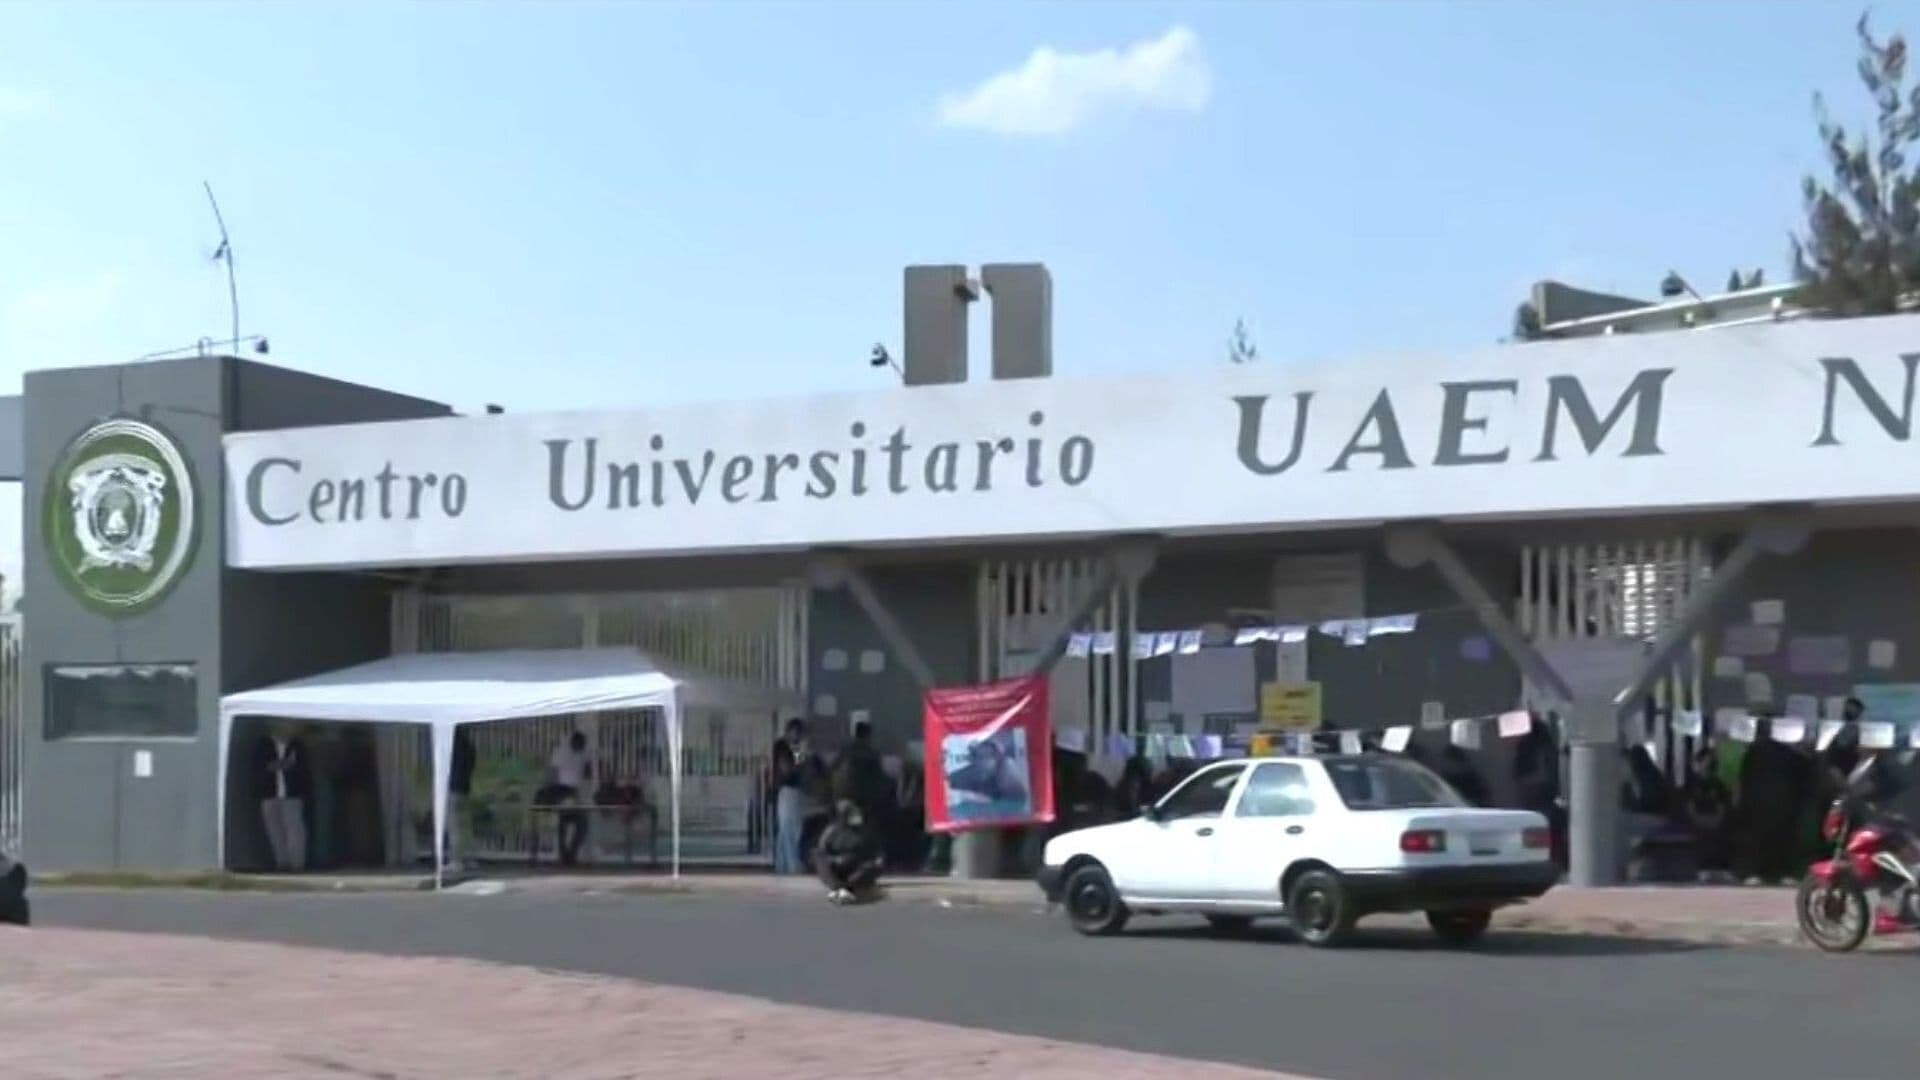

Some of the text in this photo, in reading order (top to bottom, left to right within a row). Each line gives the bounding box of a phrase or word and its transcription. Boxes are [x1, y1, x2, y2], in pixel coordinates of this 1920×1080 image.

[246, 352, 1920, 526] Centro Universitario UAEM N
